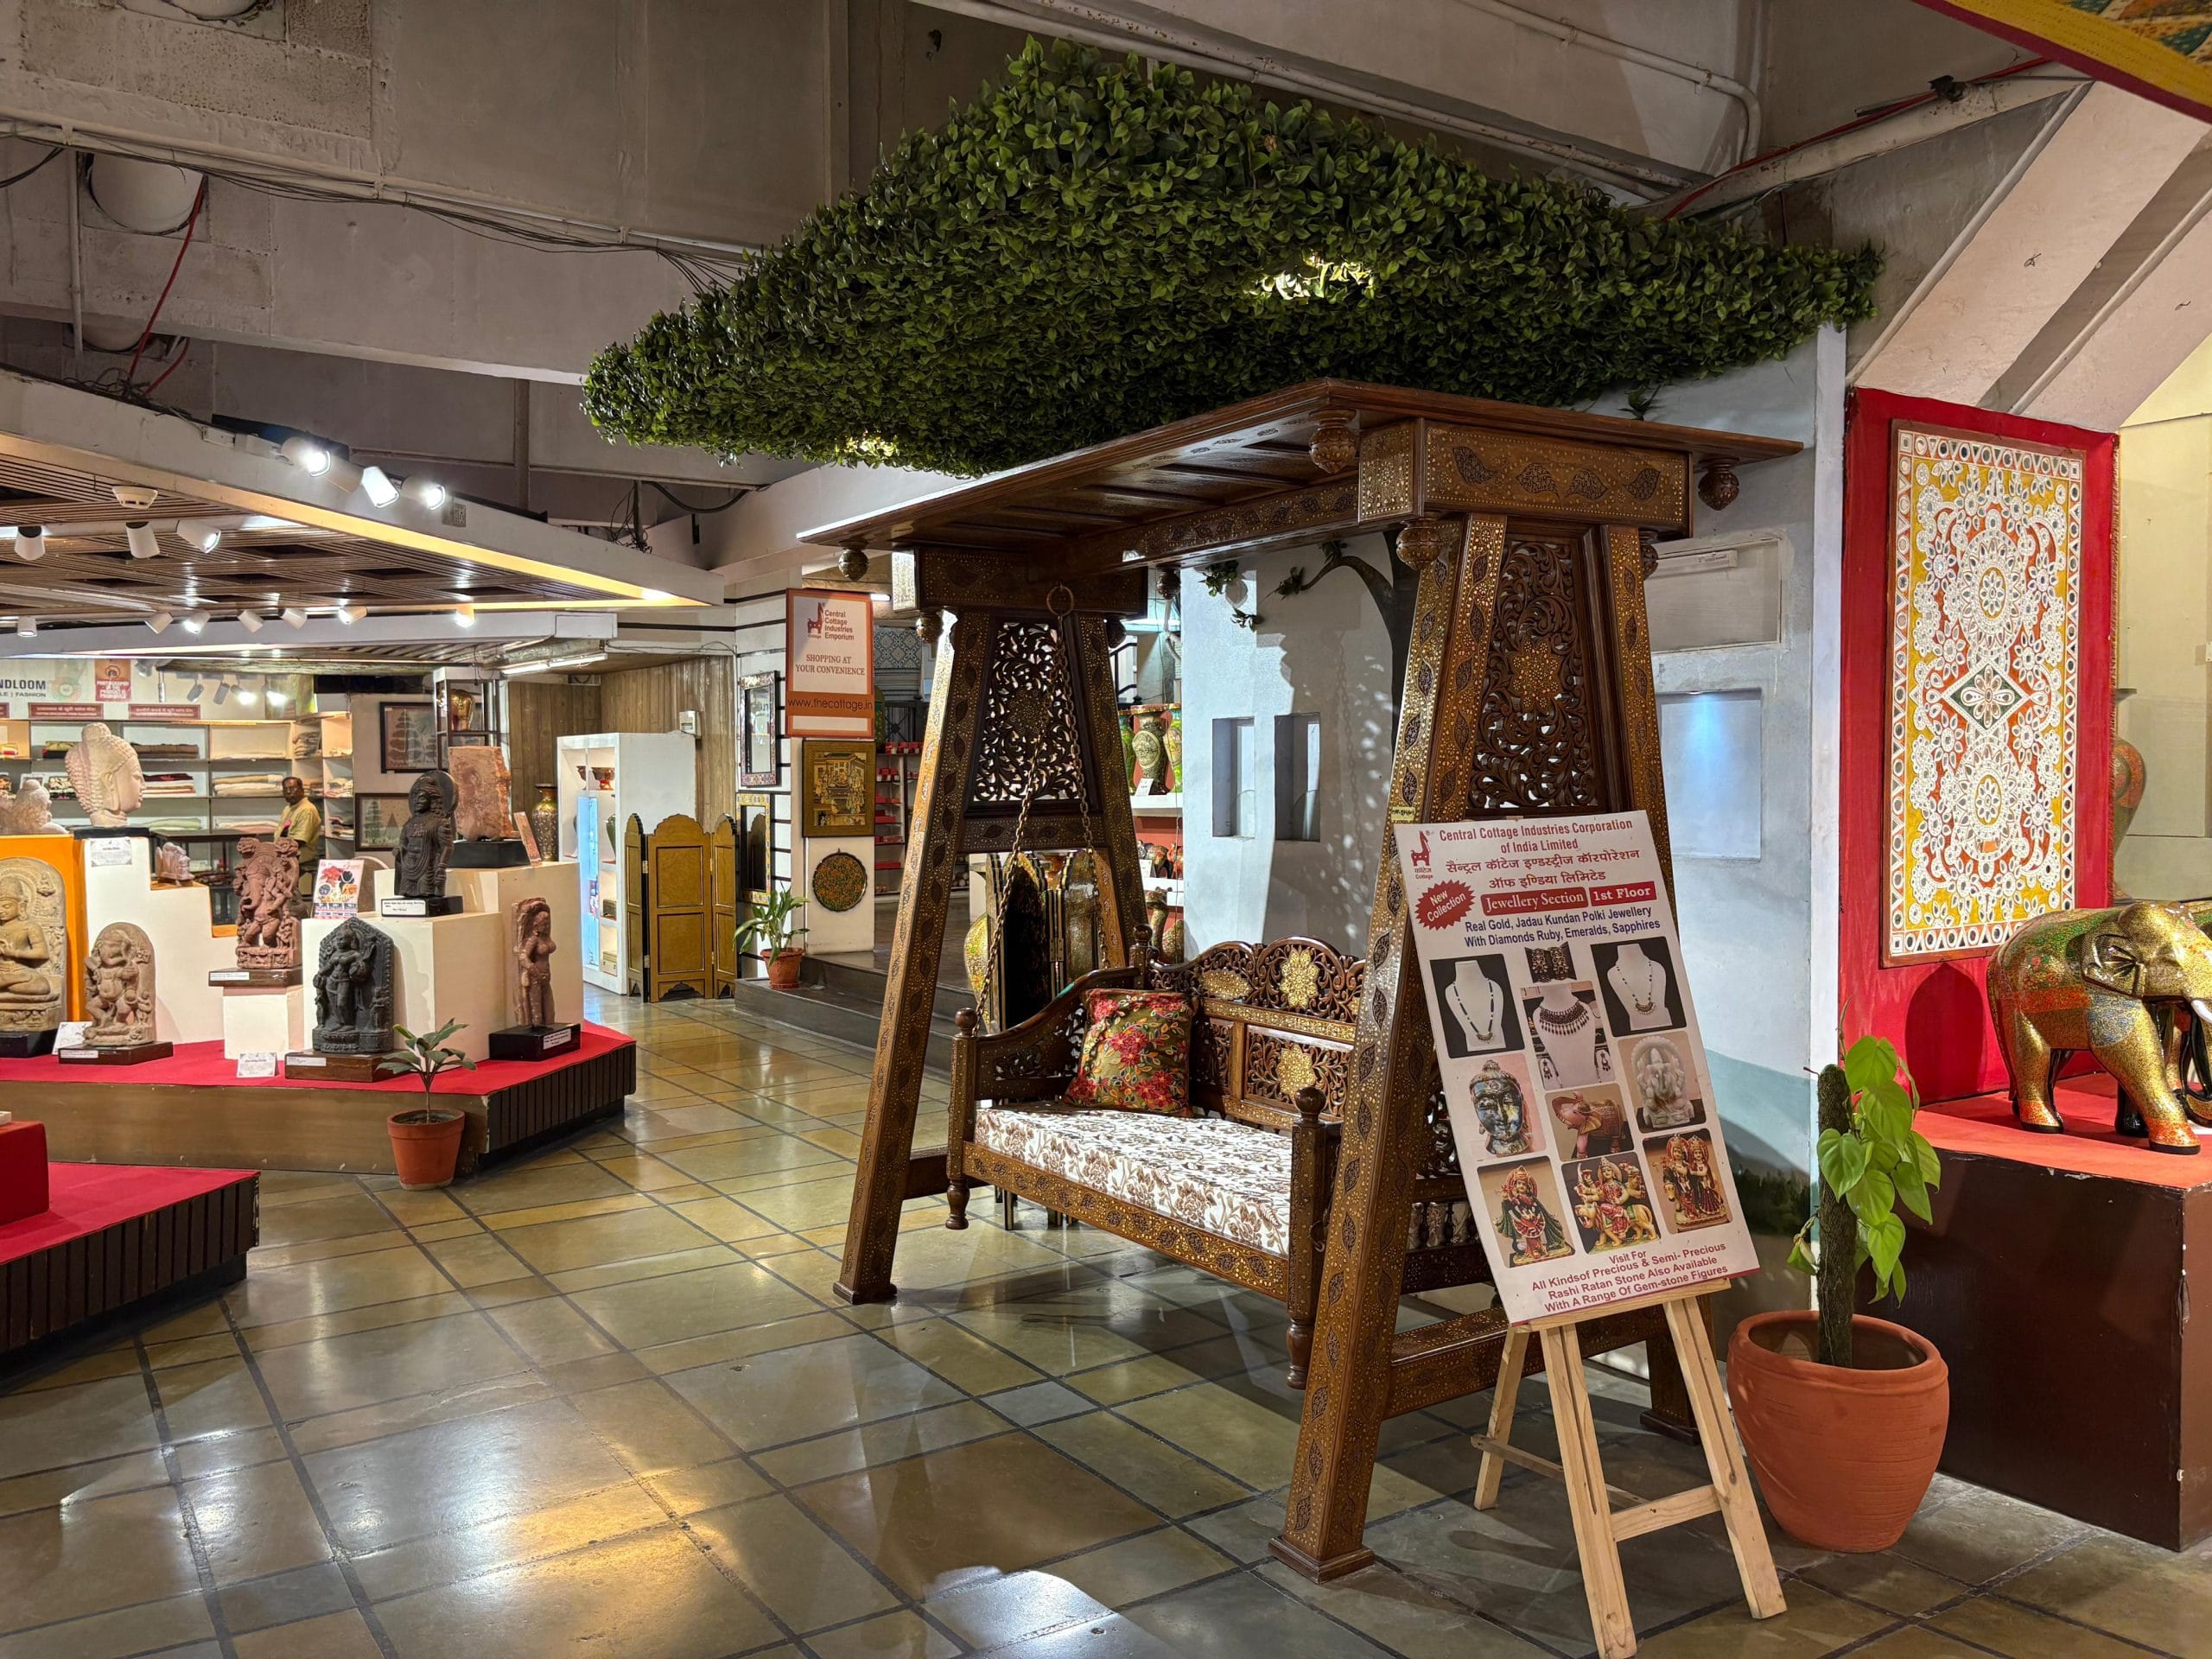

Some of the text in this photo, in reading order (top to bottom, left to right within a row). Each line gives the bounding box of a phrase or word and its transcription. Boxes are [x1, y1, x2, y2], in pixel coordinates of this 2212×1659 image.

[824, 617, 847, 626] Cottage
[824, 632, 855, 641] Emporium
[806, 654, 841, 664] SHOPPING
[796, 664, 865, 676] YOUR CONVENIENCE
[788, 697, 873, 712] www.thecottage.in
[1440, 819, 1633, 842] Central Cottage Industries Corporation
[1501, 838, 1579, 853] of India Limited
[1484, 857, 1519, 870] कॉटेज
[1577, 849, 1640, 863] कॉरपोरेशन
[1489, 869, 1606, 888] ऑफ इण्डिया लिमिटेड
[1430, 890, 1448, 906] New
[1486, 892, 1584, 912] Jewellery Section
[1593, 887, 1651, 901] 1st Floor
[1427, 893, 1466, 922] Collection
[1465, 906, 1652, 932] Real Gold, Jadau Kundan Polki Jewellery
[1465, 919, 1661, 947] With Diamonds Ruby, Emeralds, Sapphires
[1609, 1250, 1647, 1264] Visit For
[1532, 1243, 1726, 1291] All Kindsof Precious & Semi- Precious
[1548, 1256, 1718, 1300] Rashi Ratan Stone Also Available
[1544, 1266, 1728, 1313] With A Range Of Gem-stone Figures
